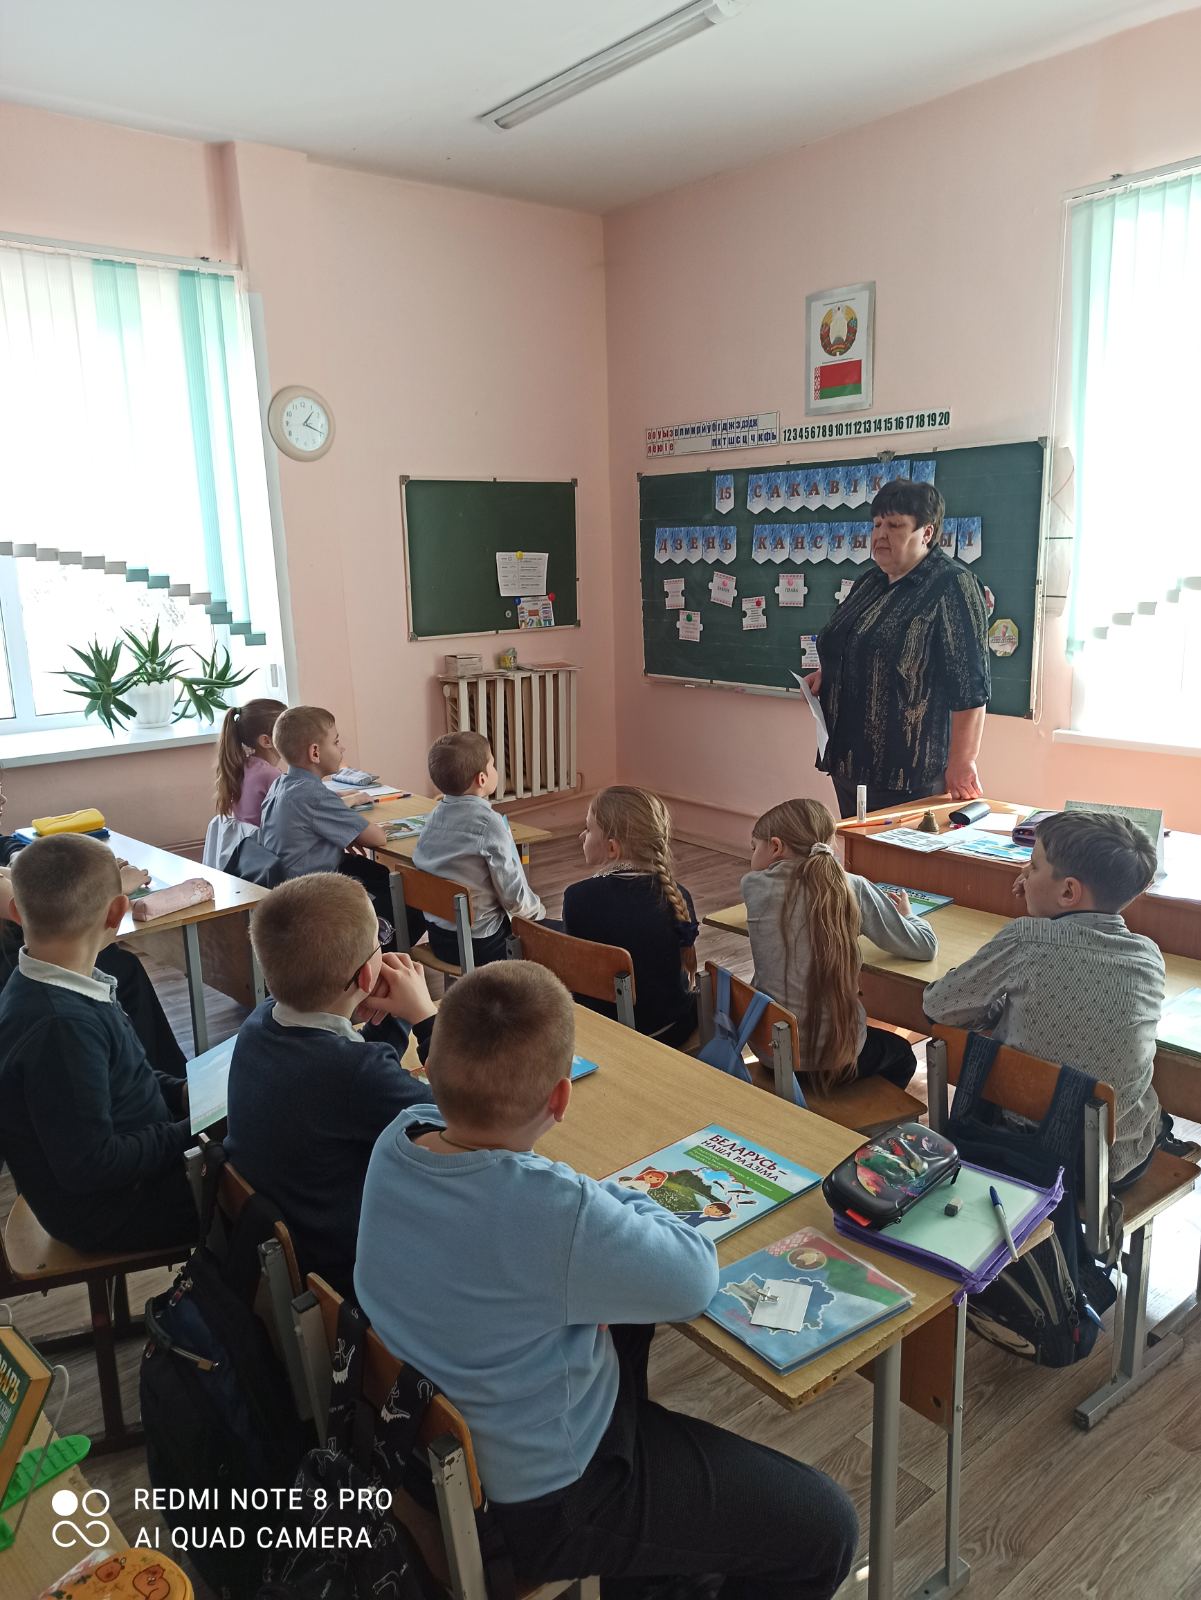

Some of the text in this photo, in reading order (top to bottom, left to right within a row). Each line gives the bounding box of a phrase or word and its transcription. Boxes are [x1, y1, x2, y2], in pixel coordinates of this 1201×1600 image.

[719, 488, 731, 500] 15
[658, 536, 733, 553] ДЗЕНЬ
[701, 1140, 731, 1158] НАША
[733, 1156, 779, 1182] РАДЗІМА
[708, 1134, 779, 1171] БЕЛАРУСЬ
